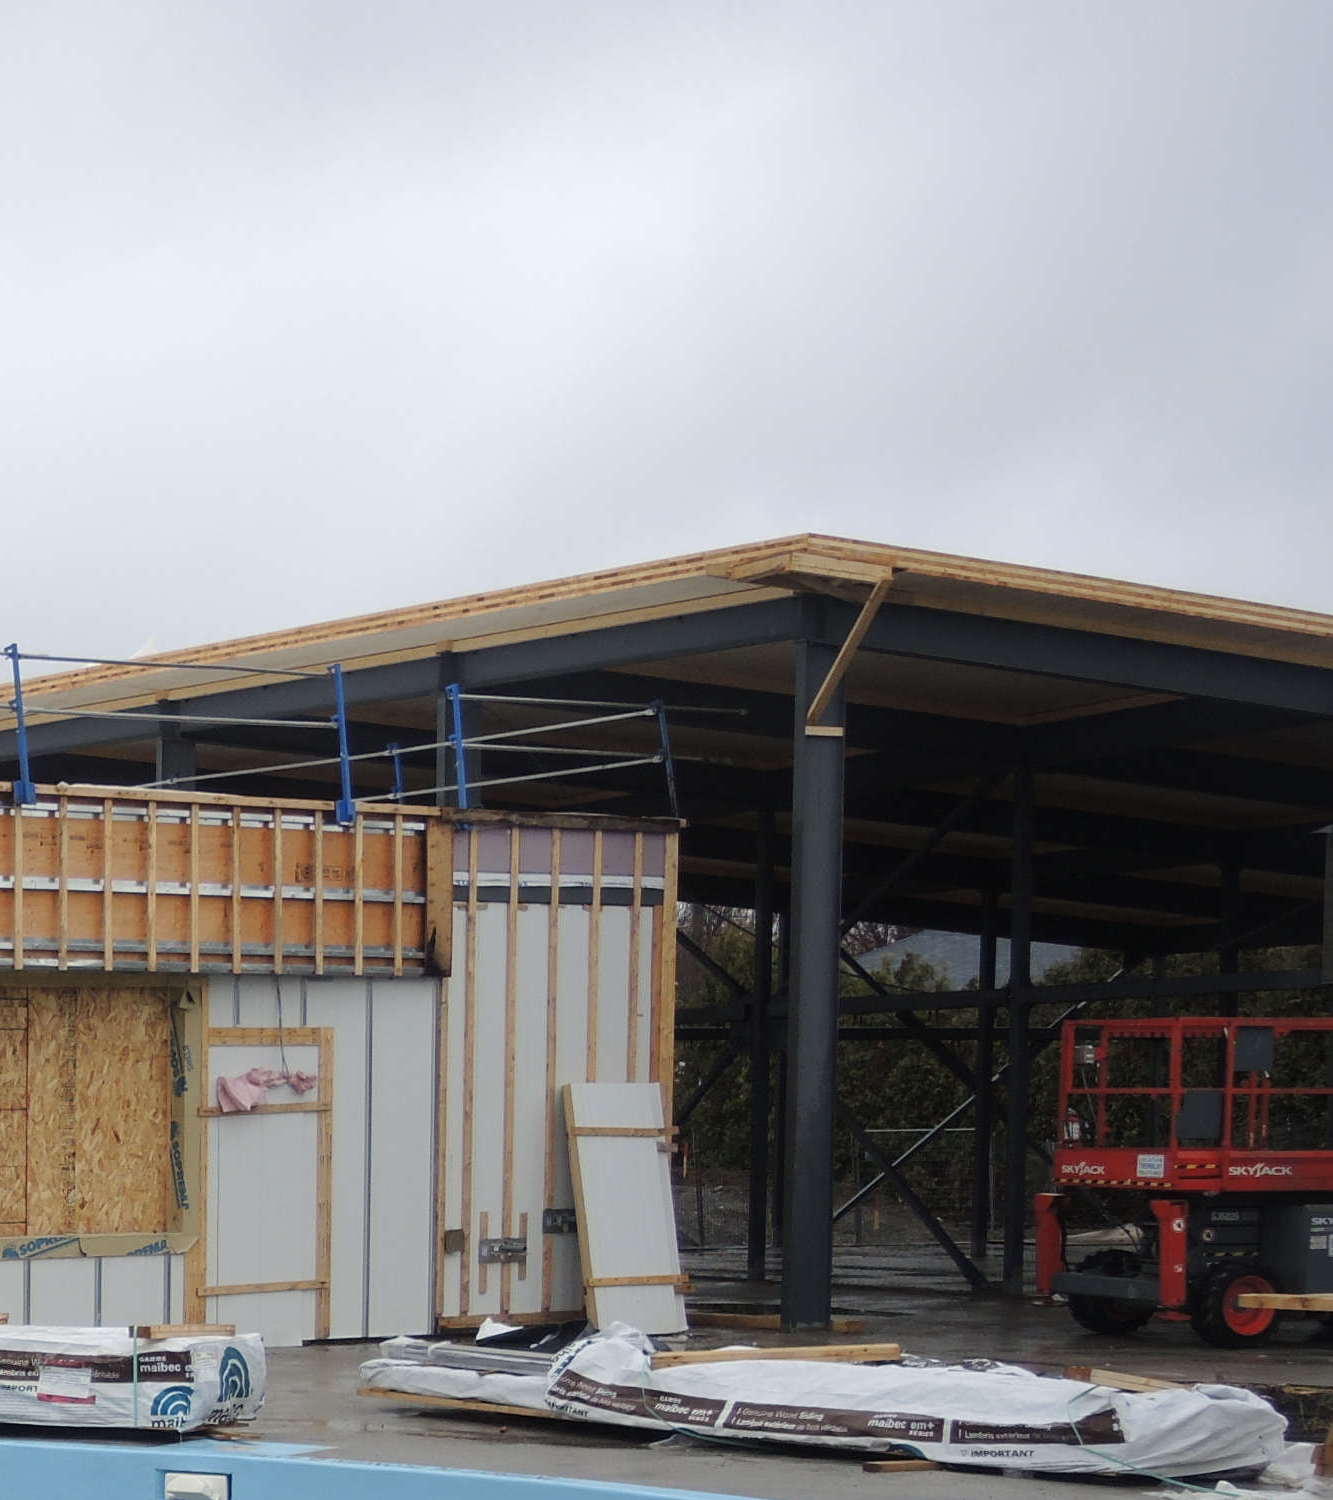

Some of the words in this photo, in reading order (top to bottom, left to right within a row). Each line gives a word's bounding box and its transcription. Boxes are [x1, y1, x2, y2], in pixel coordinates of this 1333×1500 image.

[1061, 1161, 1105, 1176] SKYJACK
[1228, 1162, 1293, 1177] SKYJACK
[139, 1361, 181, 1374] maibec
[867, 1418, 907, 1430] maibec
[970, 1449, 1035, 1458] IMPORTANT
